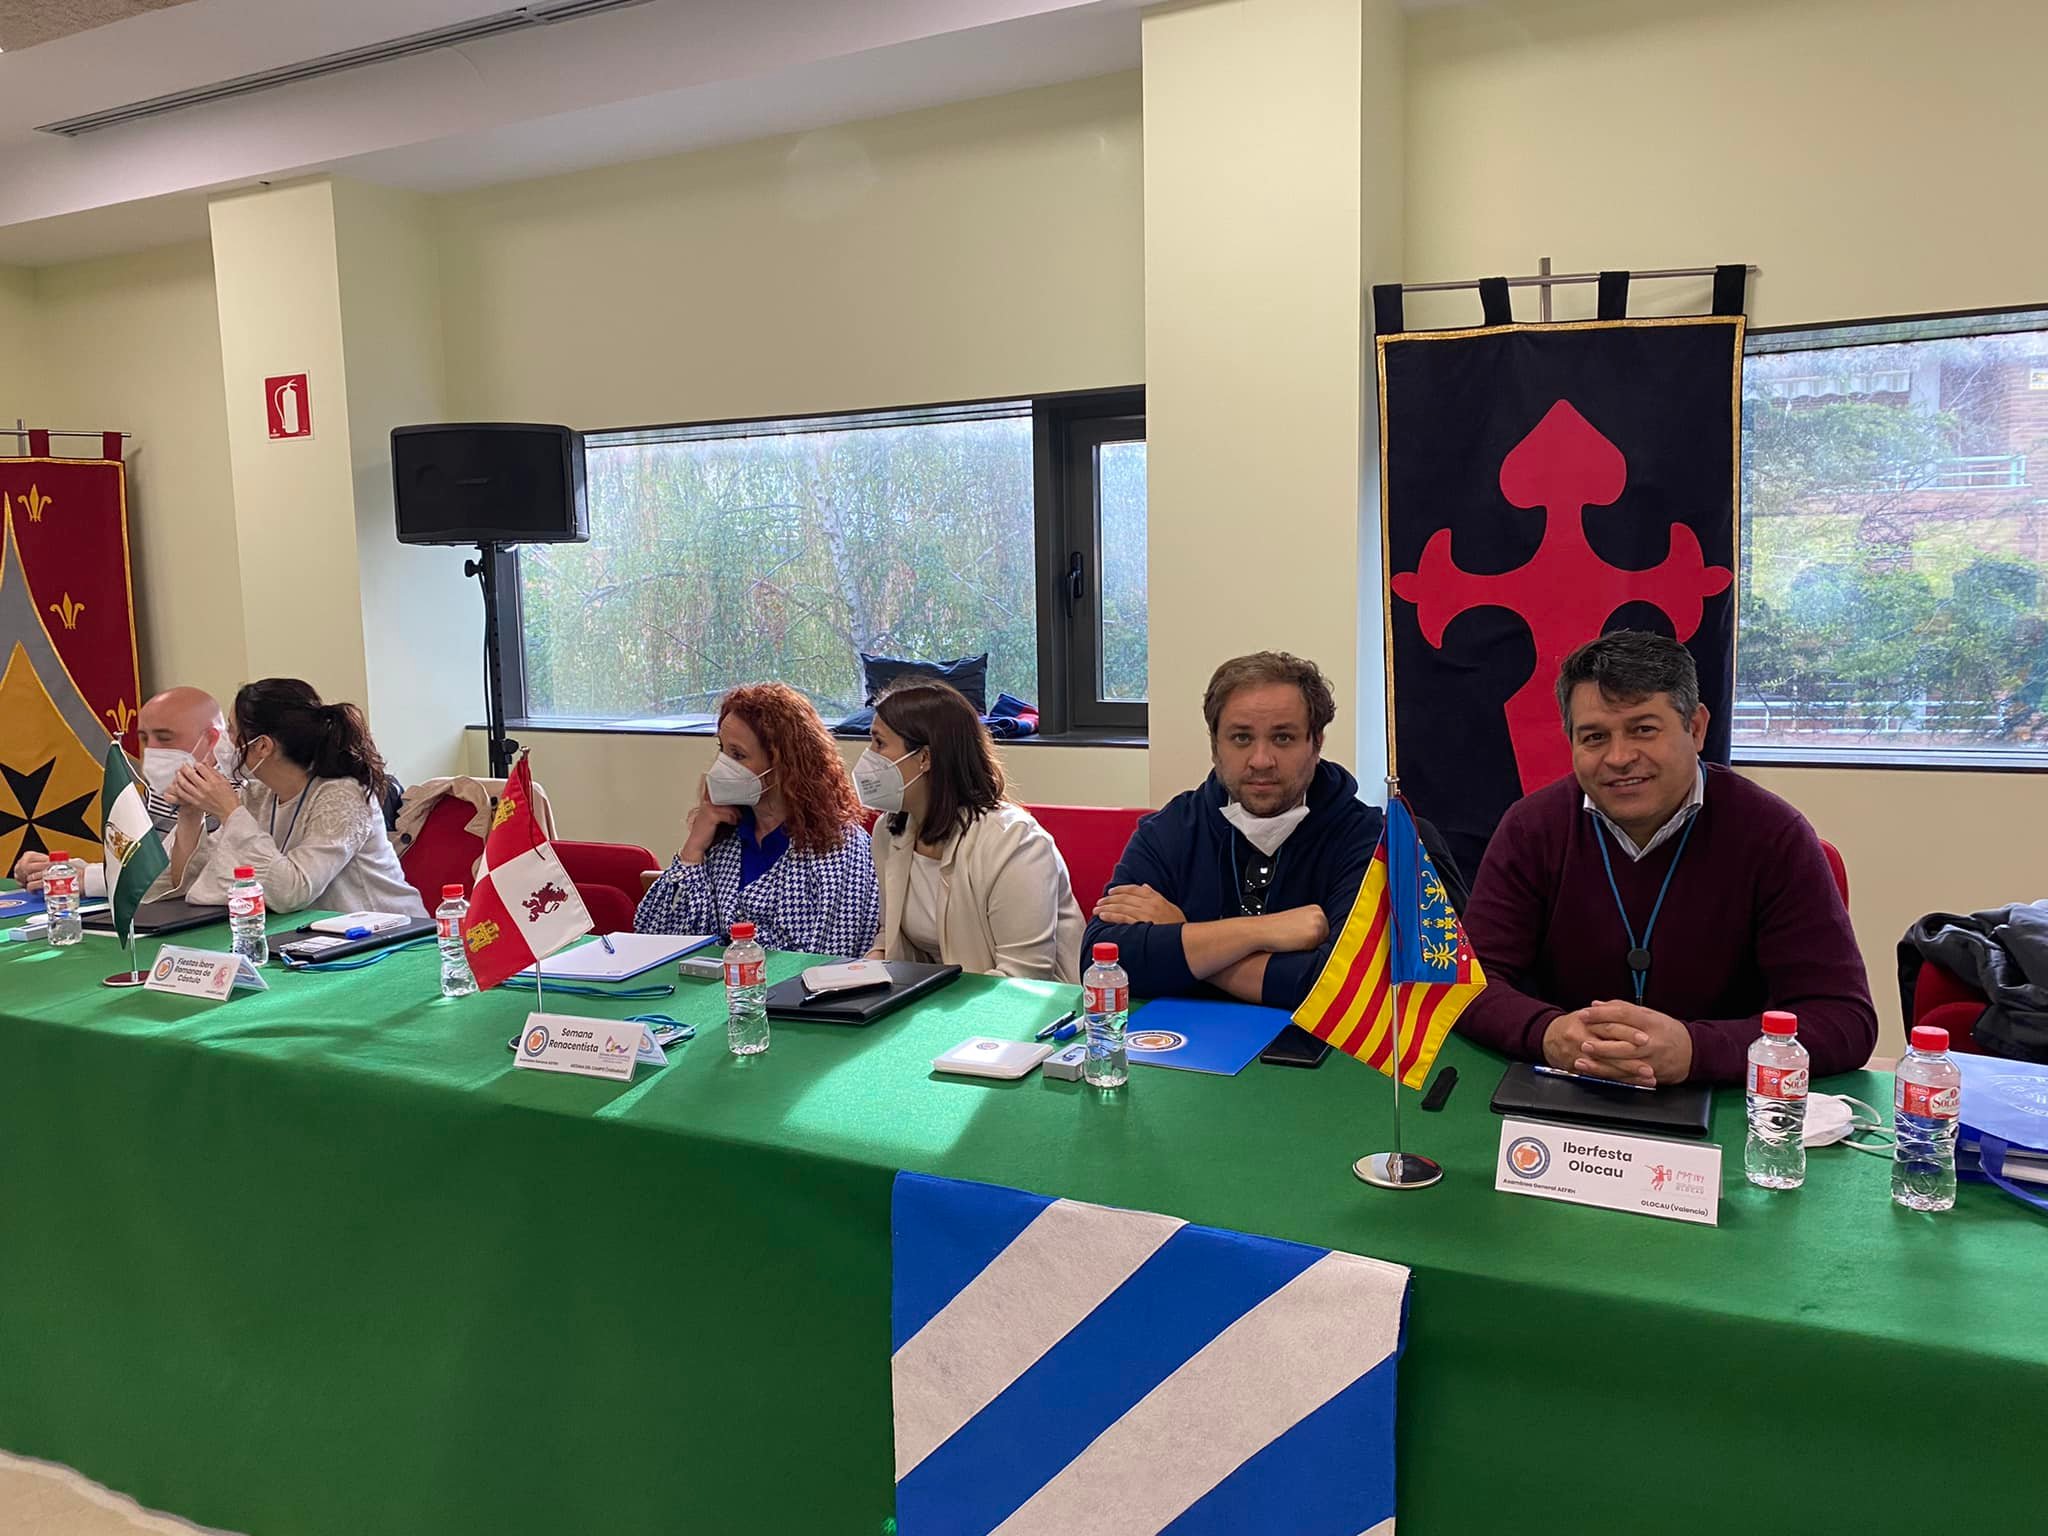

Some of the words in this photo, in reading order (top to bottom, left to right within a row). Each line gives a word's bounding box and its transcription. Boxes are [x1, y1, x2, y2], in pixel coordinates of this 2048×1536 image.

[561, 1027, 594, 1039] Semana
[548, 1041, 599, 1053] Renacentista
[1562, 1141, 1633, 1163] Iberfesta
[1568, 1159, 1624, 1179] Olocau
[1640, 1199, 1670, 1210] OLOCAU
[1670, 1203, 1709, 1217] (Valencia)
